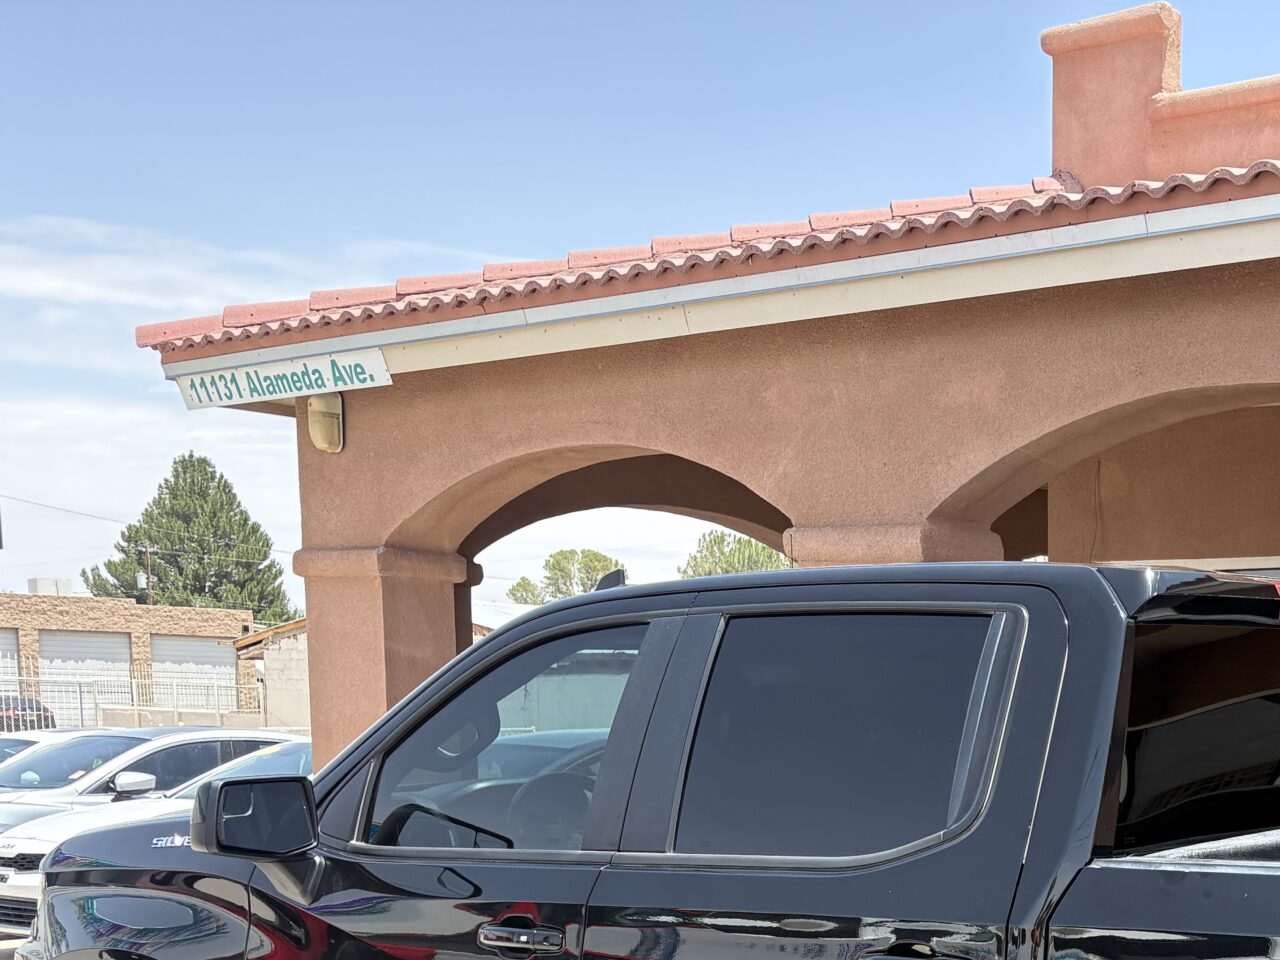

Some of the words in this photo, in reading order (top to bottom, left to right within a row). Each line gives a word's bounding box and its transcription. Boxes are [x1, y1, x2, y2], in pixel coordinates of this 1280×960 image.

[190, 372, 244, 404] 11131
[245, 363, 327, 398] Alameda
[330, 359, 375, 387] Ave.
